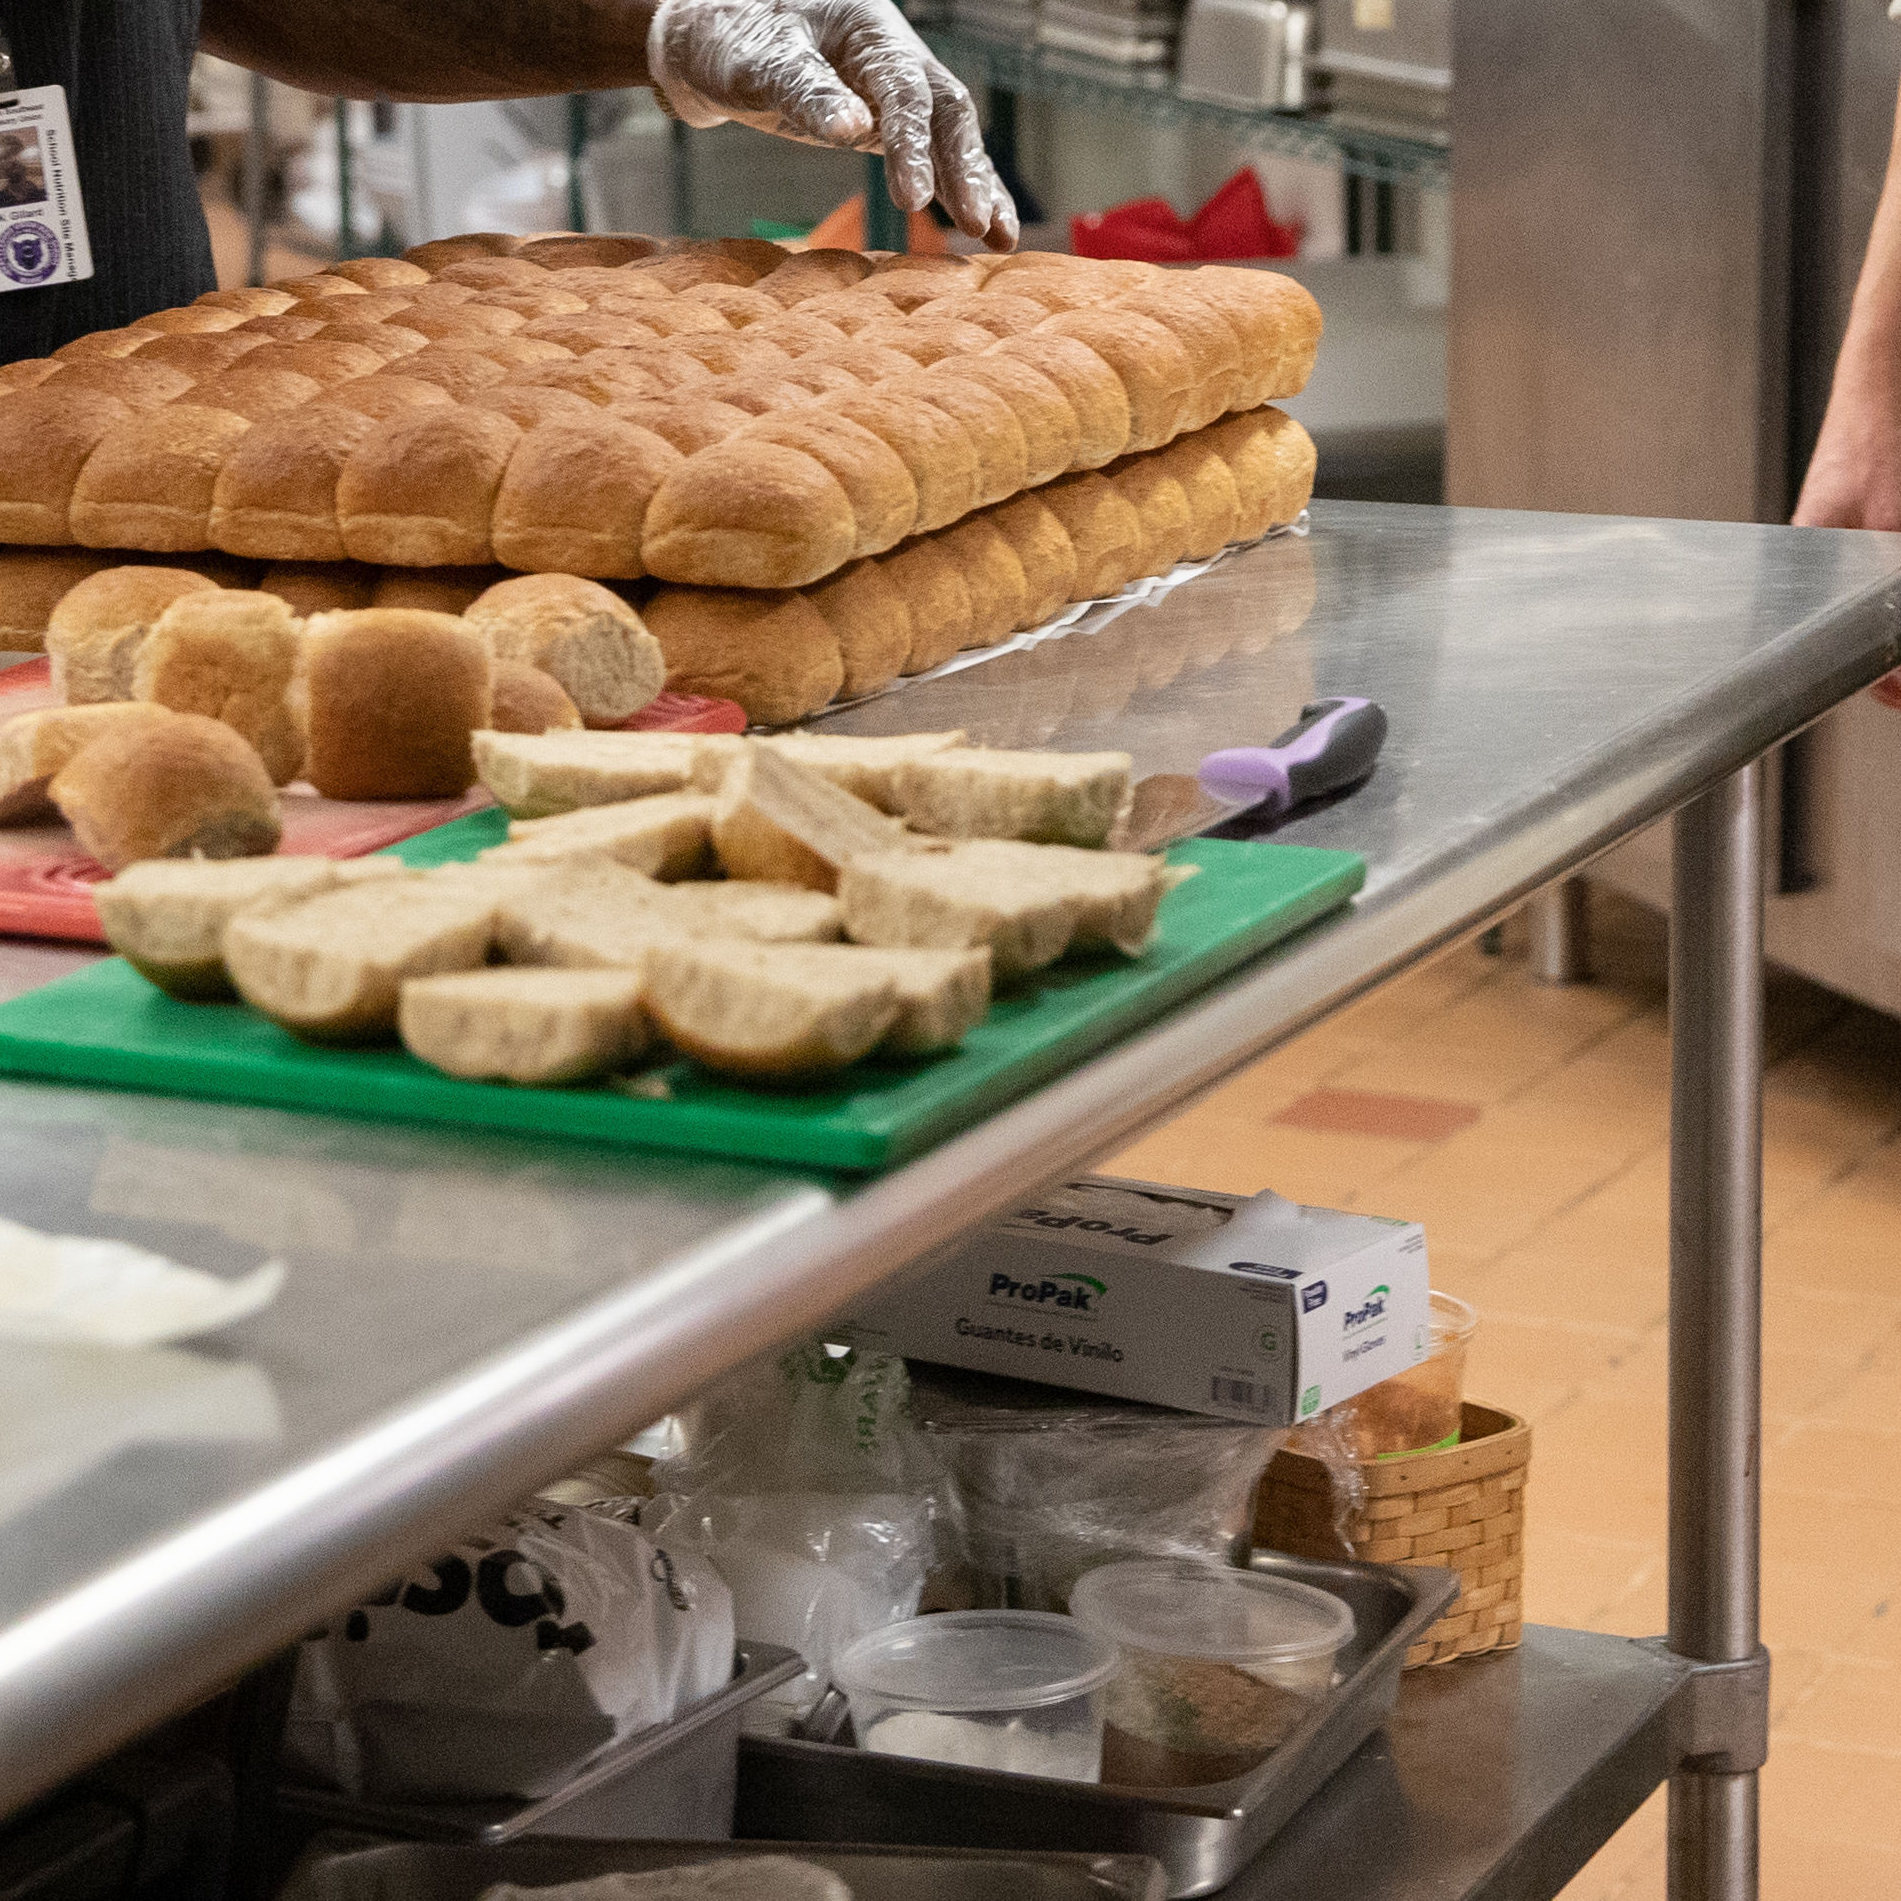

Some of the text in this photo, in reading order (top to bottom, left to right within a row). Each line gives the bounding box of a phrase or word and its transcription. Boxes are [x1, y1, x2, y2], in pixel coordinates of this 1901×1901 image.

[46, 129, 61, 167] School
[989, 1272, 1091, 1311] ProPak
[955, 1317, 1036, 1348] Guantes
[1040, 1332, 1064, 1353] de
